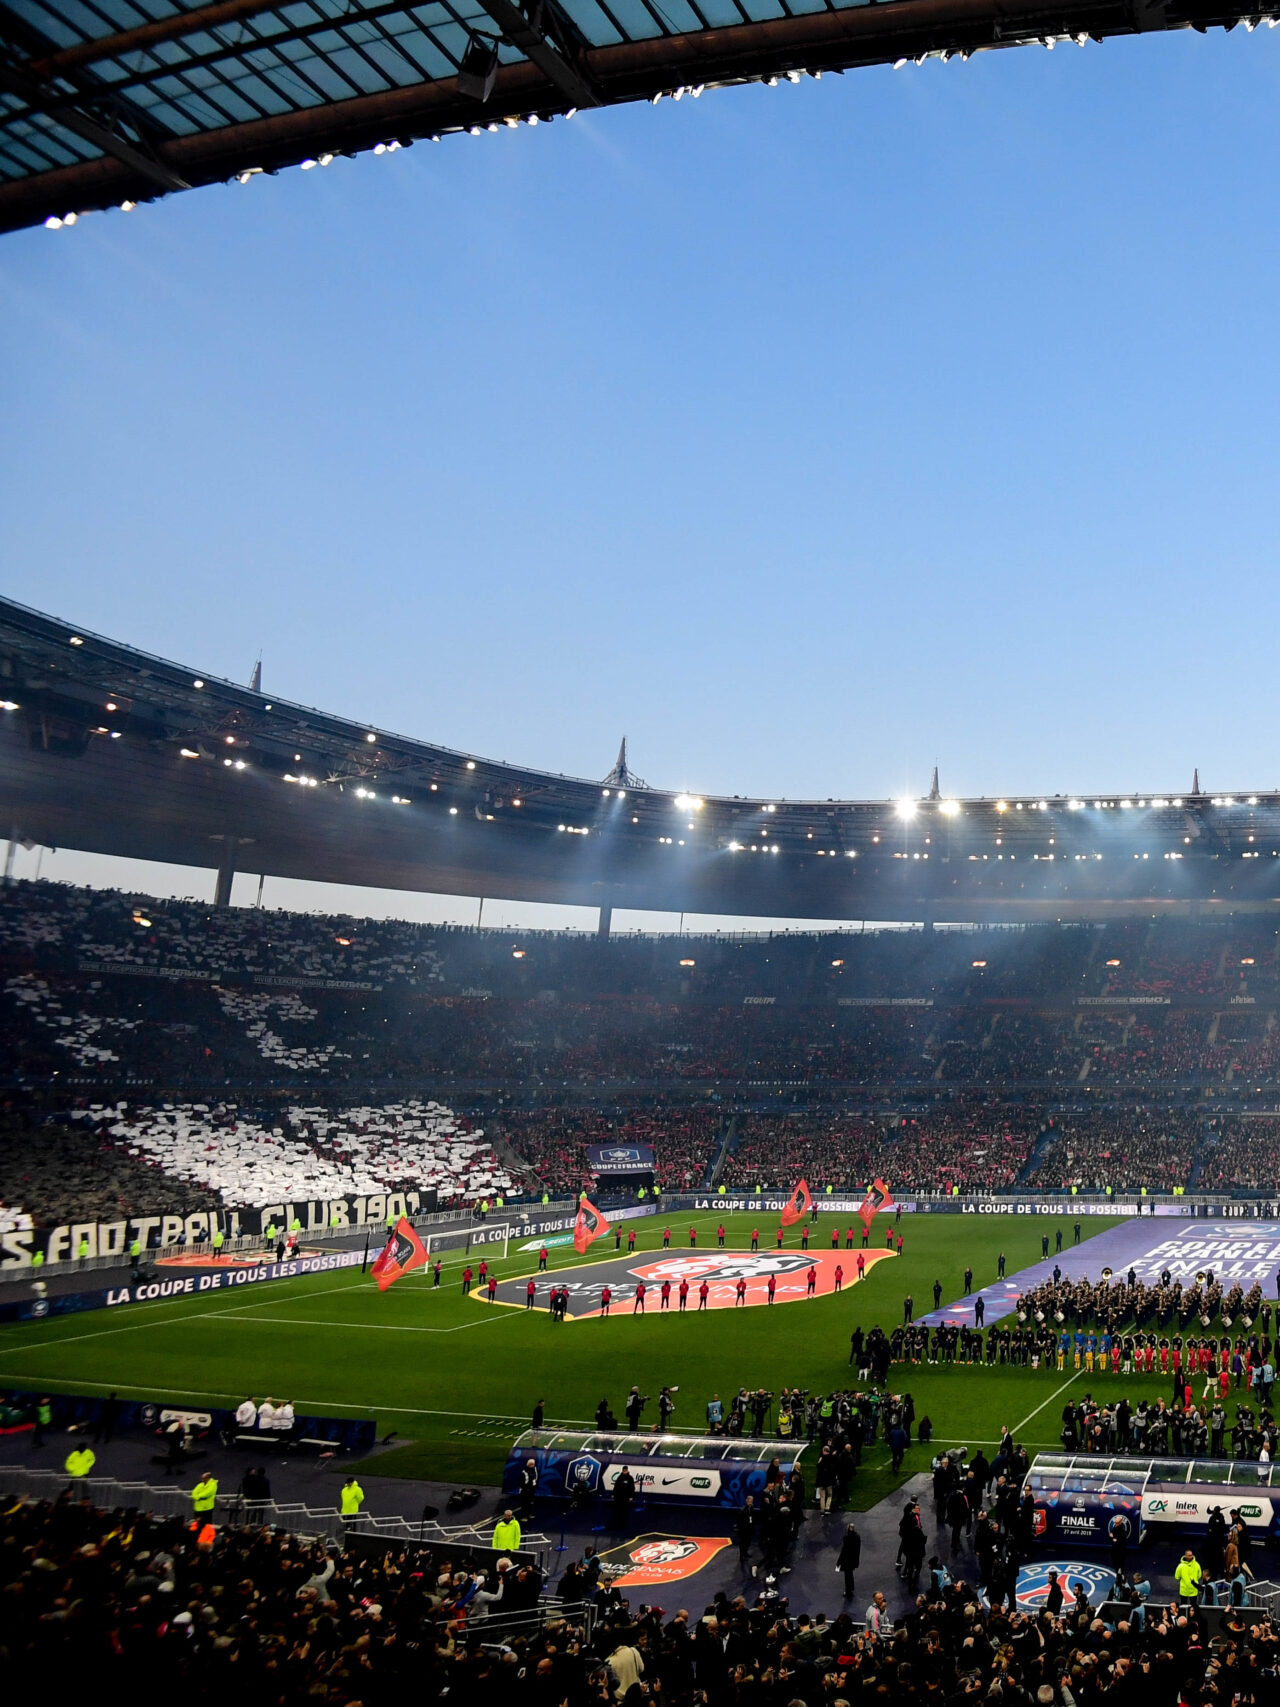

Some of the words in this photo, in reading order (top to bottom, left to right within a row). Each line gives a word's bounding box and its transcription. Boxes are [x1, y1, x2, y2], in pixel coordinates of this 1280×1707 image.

[695, 1200, 709, 1209] LA
[712, 1200, 745, 1209] COUPE
[750, 1201, 762, 1210] DE
[962, 1204, 975, 1213] LA
[978, 1204, 1014, 1213] COUPE
[1017, 1204, 1032, 1214] DE
[1035, 1204, 1063, 1214] TOUS
[1066, 1205, 1086, 1214] LES
[261, 1199, 349, 1236] CLUB
[353, 1191, 420, 1226] 1901
[472, 1233, 486, 1245] LA
[489, 1225, 521, 1242] COUPE
[524, 1223, 537, 1236] DE
[539, 1220, 562, 1233] TOUS
[107, 1288, 131, 1305] LA
[136, 1278, 194, 1300] COUPE
[199, 1273, 222, 1290] DE
[227, 1264, 268, 1286] TOUS
[271, 1259, 297, 1278] LES
[1240, 1507, 1254, 1515] PMU
[1061, 1515, 1096, 1527] FINALE
[630, 1565, 686, 1576] RENNAIS
[1023, 1565, 1109, 1581] PARIS
